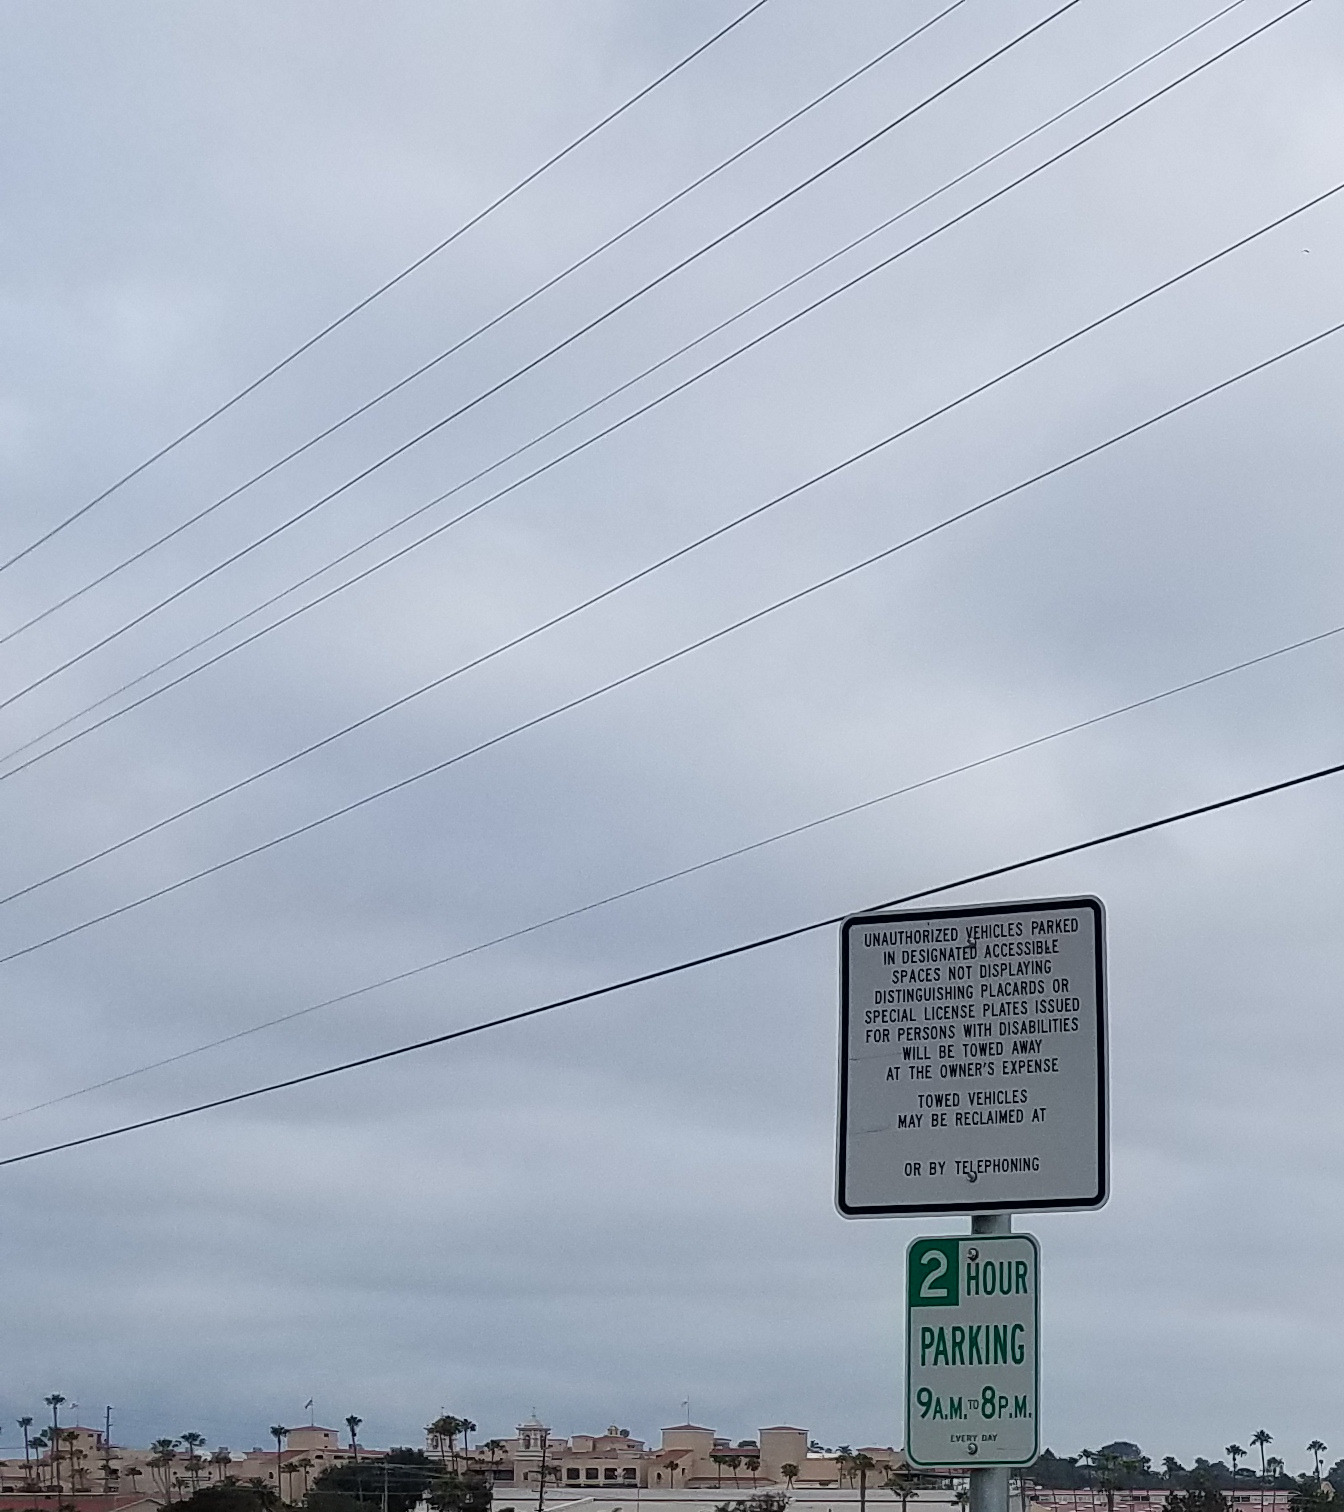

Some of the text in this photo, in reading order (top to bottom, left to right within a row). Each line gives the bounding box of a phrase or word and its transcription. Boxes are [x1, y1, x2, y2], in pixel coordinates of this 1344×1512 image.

[863, 917, 1079, 947] UNAUTHORIZED VEHICLES PARKED
[883, 938, 1060, 965] IN DESIGNATED ACCESSIBLE
[892, 960, 1052, 984] SPACES NOT DISPLAYING
[874, 978, 1069, 1005] DISTINGUISHING PLACARDS OR
[864, 998, 1080, 1024] SPECIAL LICENSE PLATES ISSUED
[865, 1017, 1079, 1043] FOR PERSONS WITH DISABILITIES
[901, 1039, 1043, 1061] WILL BE TOWED AWAY
[886, 1058, 1059, 1081] AT THE OWNER'S EXPENSE
[917, 1089, 1028, 1109] TOWED VEHICLES
[897, 1107, 1046, 1129] MAY BE RECLAIMED AT
[904, 1157, 1040, 1177] OR BY TELEPHONING
[919, 1249, 1028, 1298] 2 HOUR
[920, 1323, 1025, 1367] PARKING
[968, 1399, 979, 1410] TO
[950, 1434, 998, 1443] EVERY DAY
